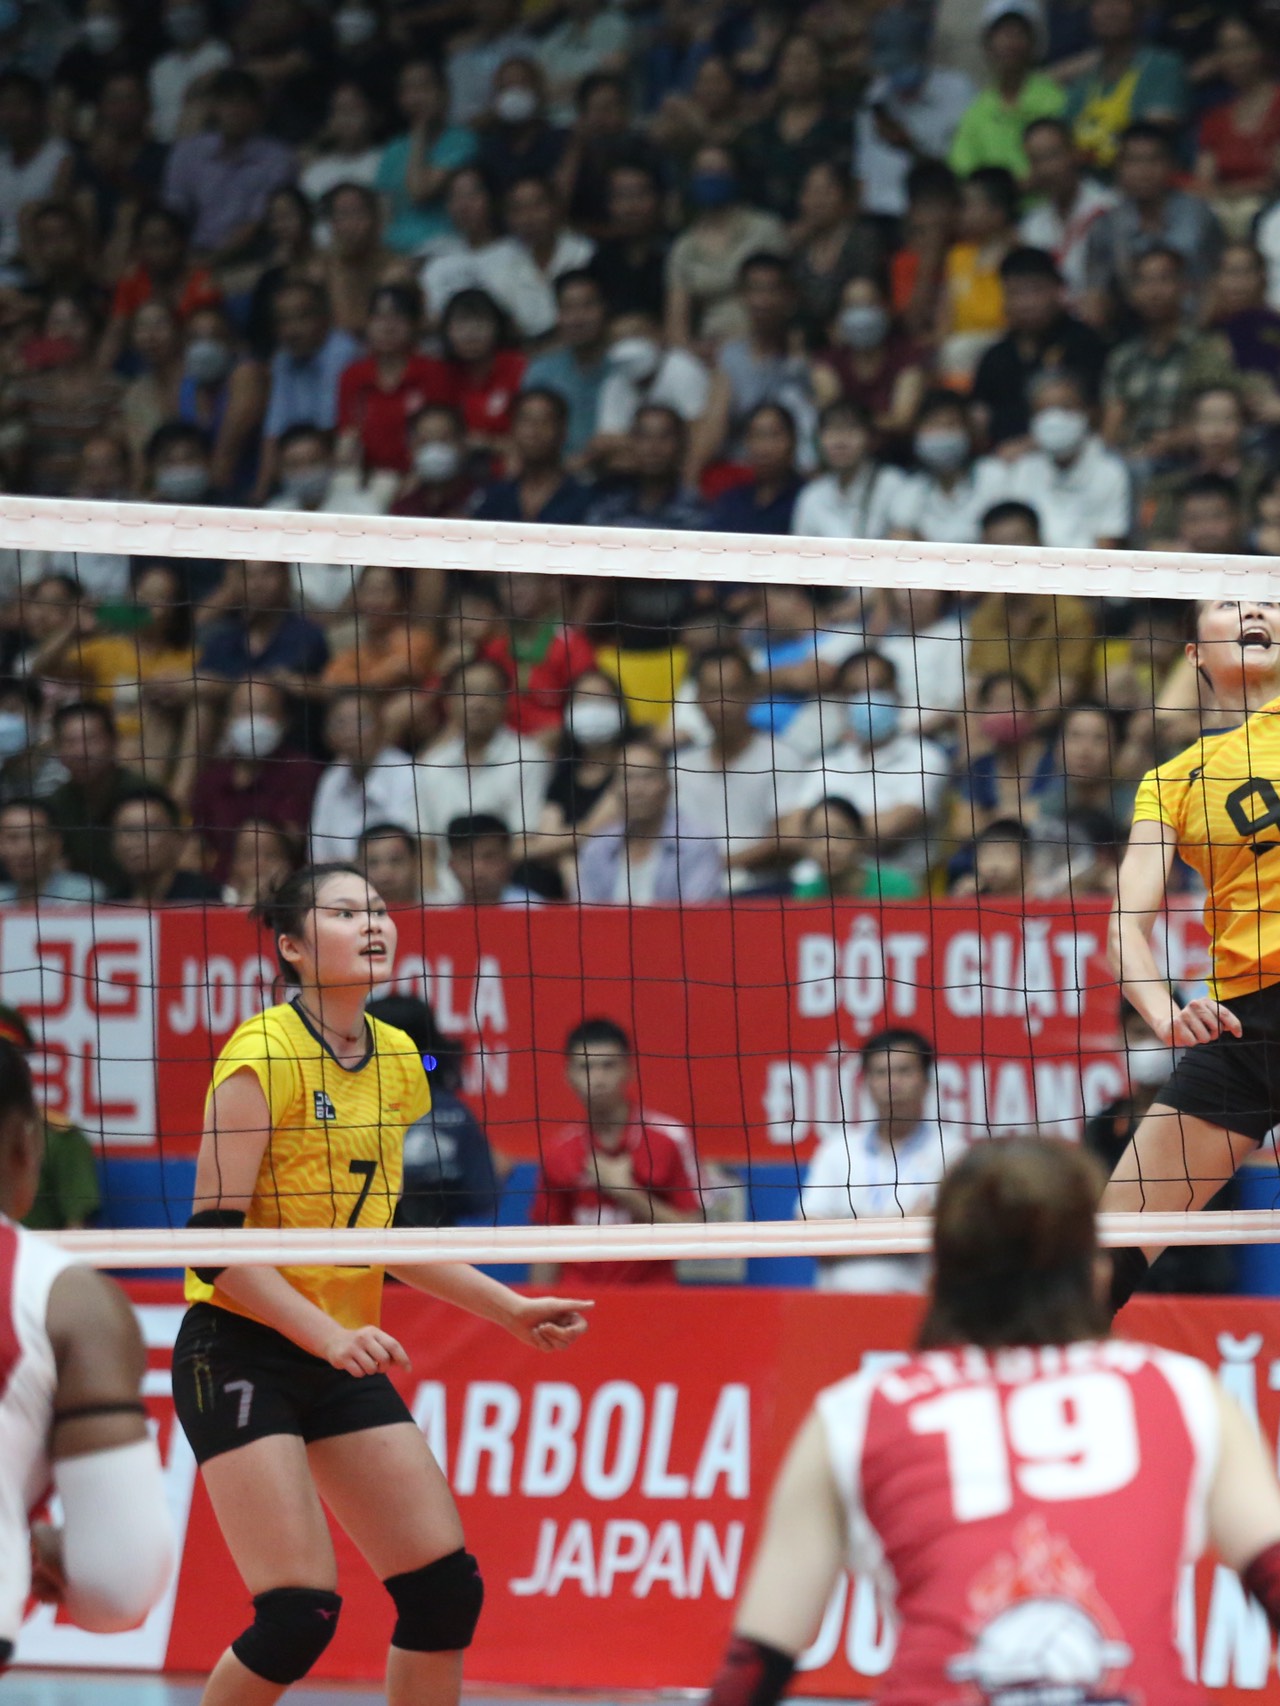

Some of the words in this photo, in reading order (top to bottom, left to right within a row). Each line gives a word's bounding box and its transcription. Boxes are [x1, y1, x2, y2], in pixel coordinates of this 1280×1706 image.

[168, 953, 508, 1036] JOGOLA
[797, 913, 928, 1037] BỘT
[943, 919, 1098, 1037] GIẶT
[346, 1159, 378, 1229] 7
[223, 1379, 255, 1429] 7
[411, 1379, 751, 1501] ARBOLA
[908, 1371, 1141, 1523] 19
[508, 1517, 745, 1600] JAPAN
